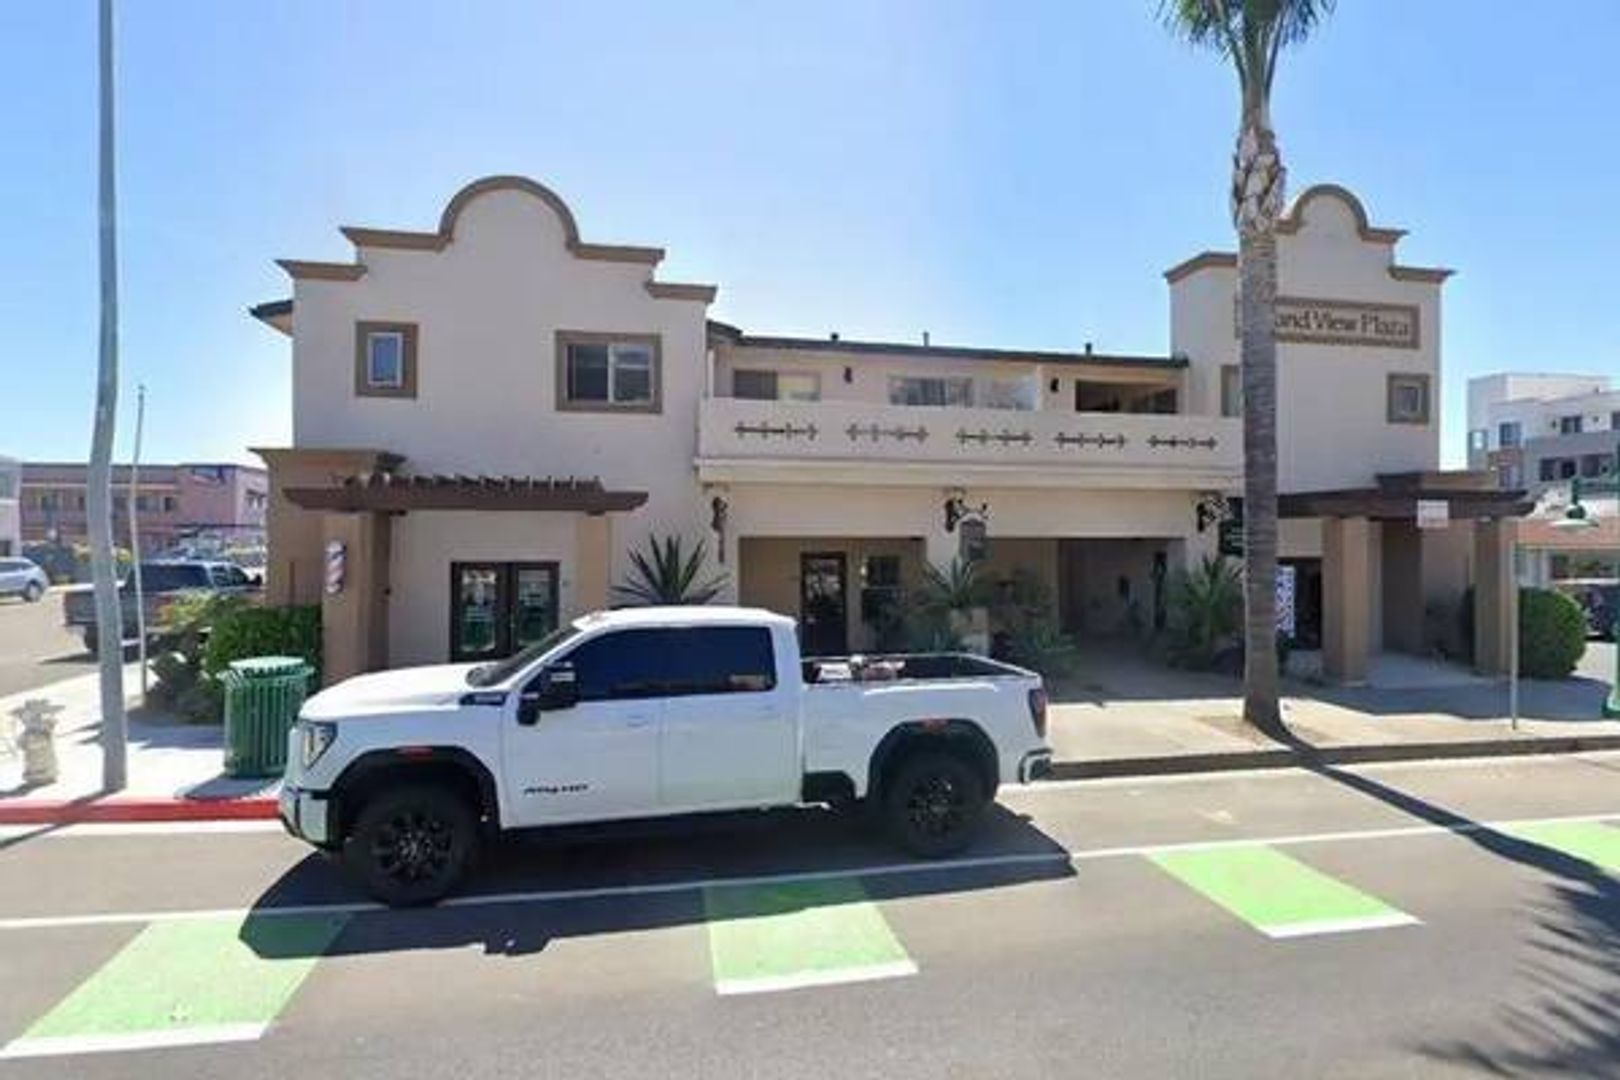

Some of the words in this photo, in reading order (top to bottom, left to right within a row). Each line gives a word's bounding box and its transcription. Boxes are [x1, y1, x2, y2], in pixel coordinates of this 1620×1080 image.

[1274, 309, 1311, 329] and
[1313, 310, 1357, 332] View
[1361, 313, 1409, 336] Plaza
